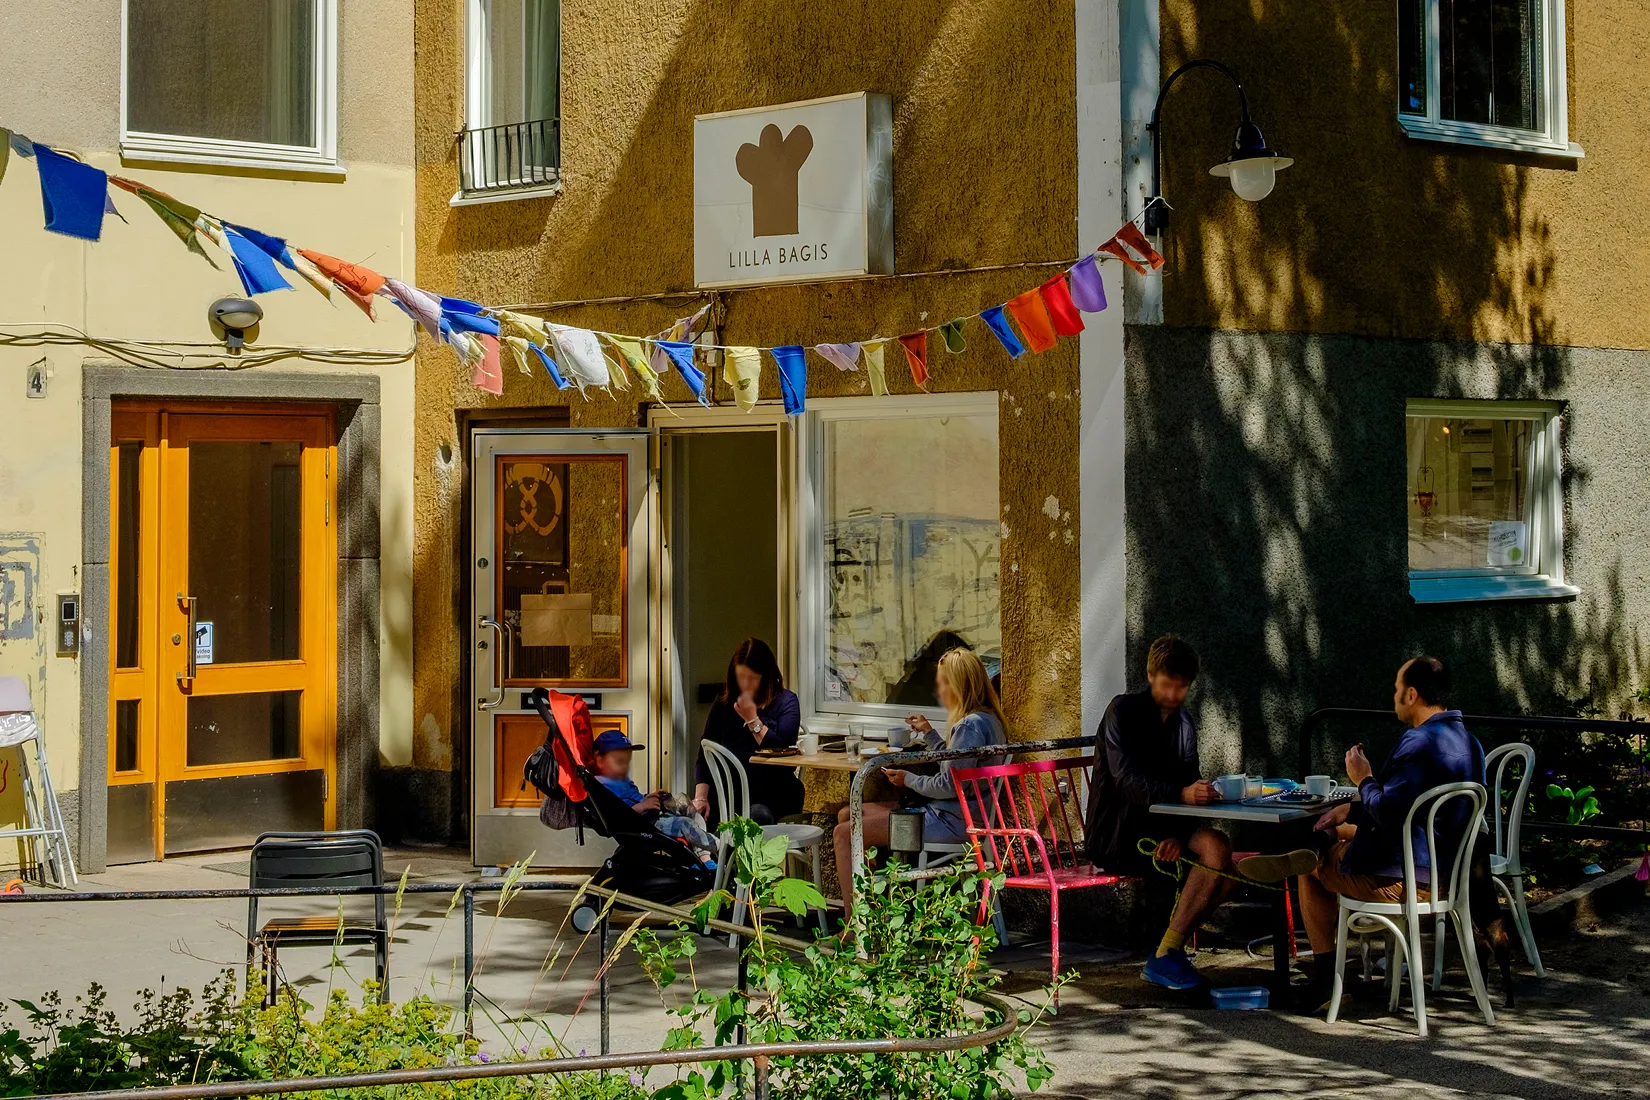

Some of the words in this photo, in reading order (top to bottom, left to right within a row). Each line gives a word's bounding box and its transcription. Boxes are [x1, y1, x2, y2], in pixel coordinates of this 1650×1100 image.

[729, 249, 771, 268] LILLA
[779, 243, 828, 264] BAGIS
[31, 371, 42, 393] 4
